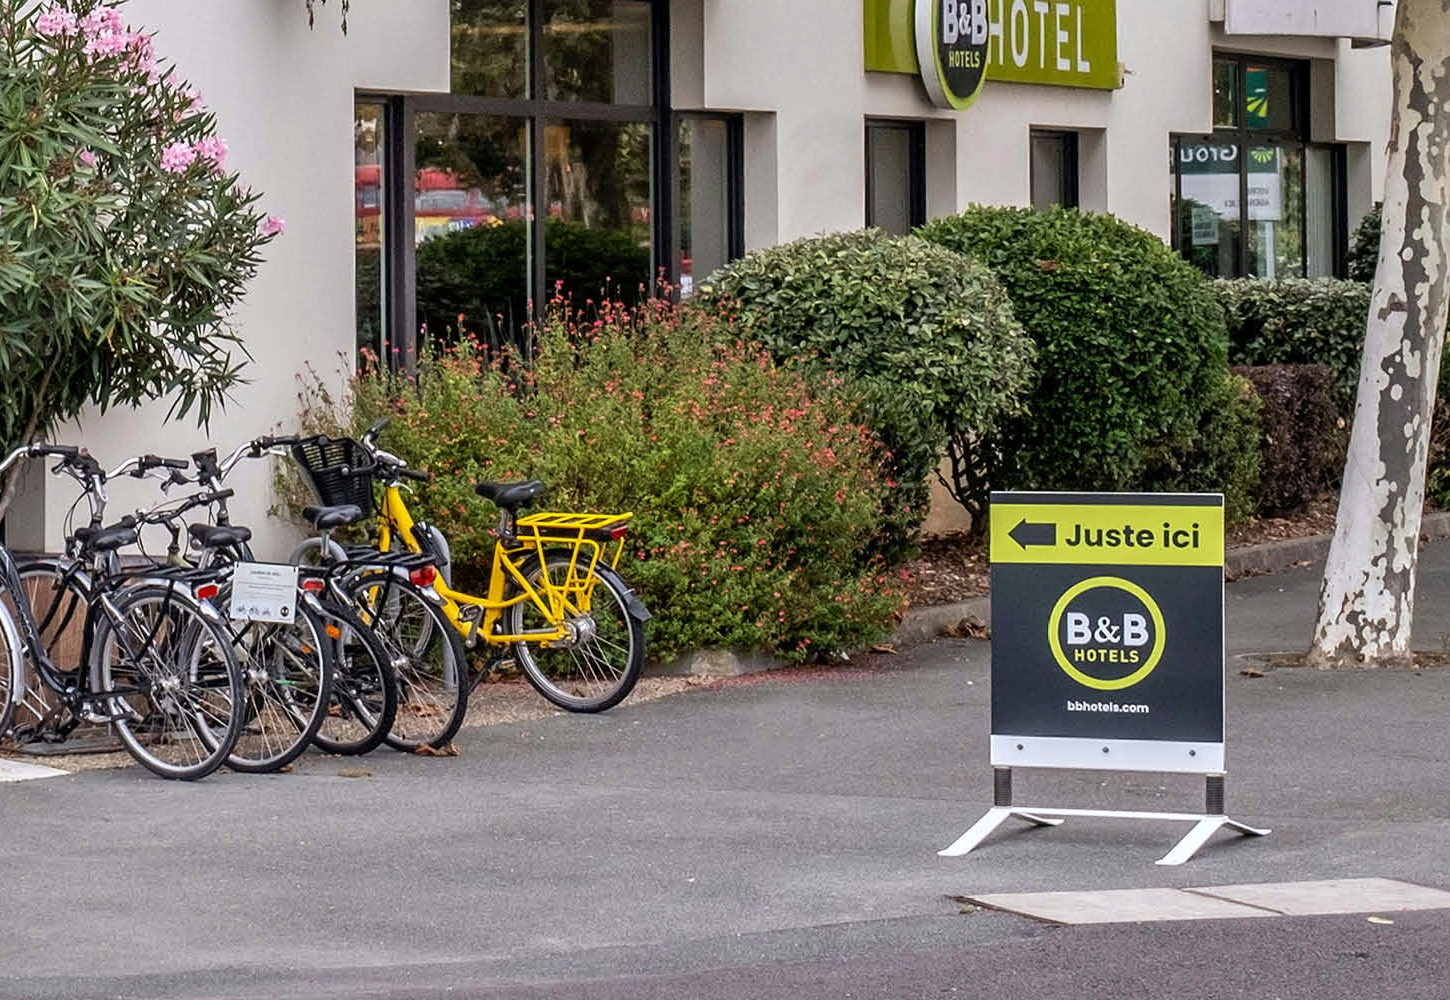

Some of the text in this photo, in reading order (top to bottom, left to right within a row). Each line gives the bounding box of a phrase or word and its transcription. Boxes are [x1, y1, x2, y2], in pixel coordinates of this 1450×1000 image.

[949, 50, 980, 68] HOTELS
[1065, 522, 1199, 549] Juste ici
[1066, 612, 1149, 647] B&B
[1074, 648, 1140, 663] HOTELS
[1067, 700, 1150, 714] bbhotels.com
